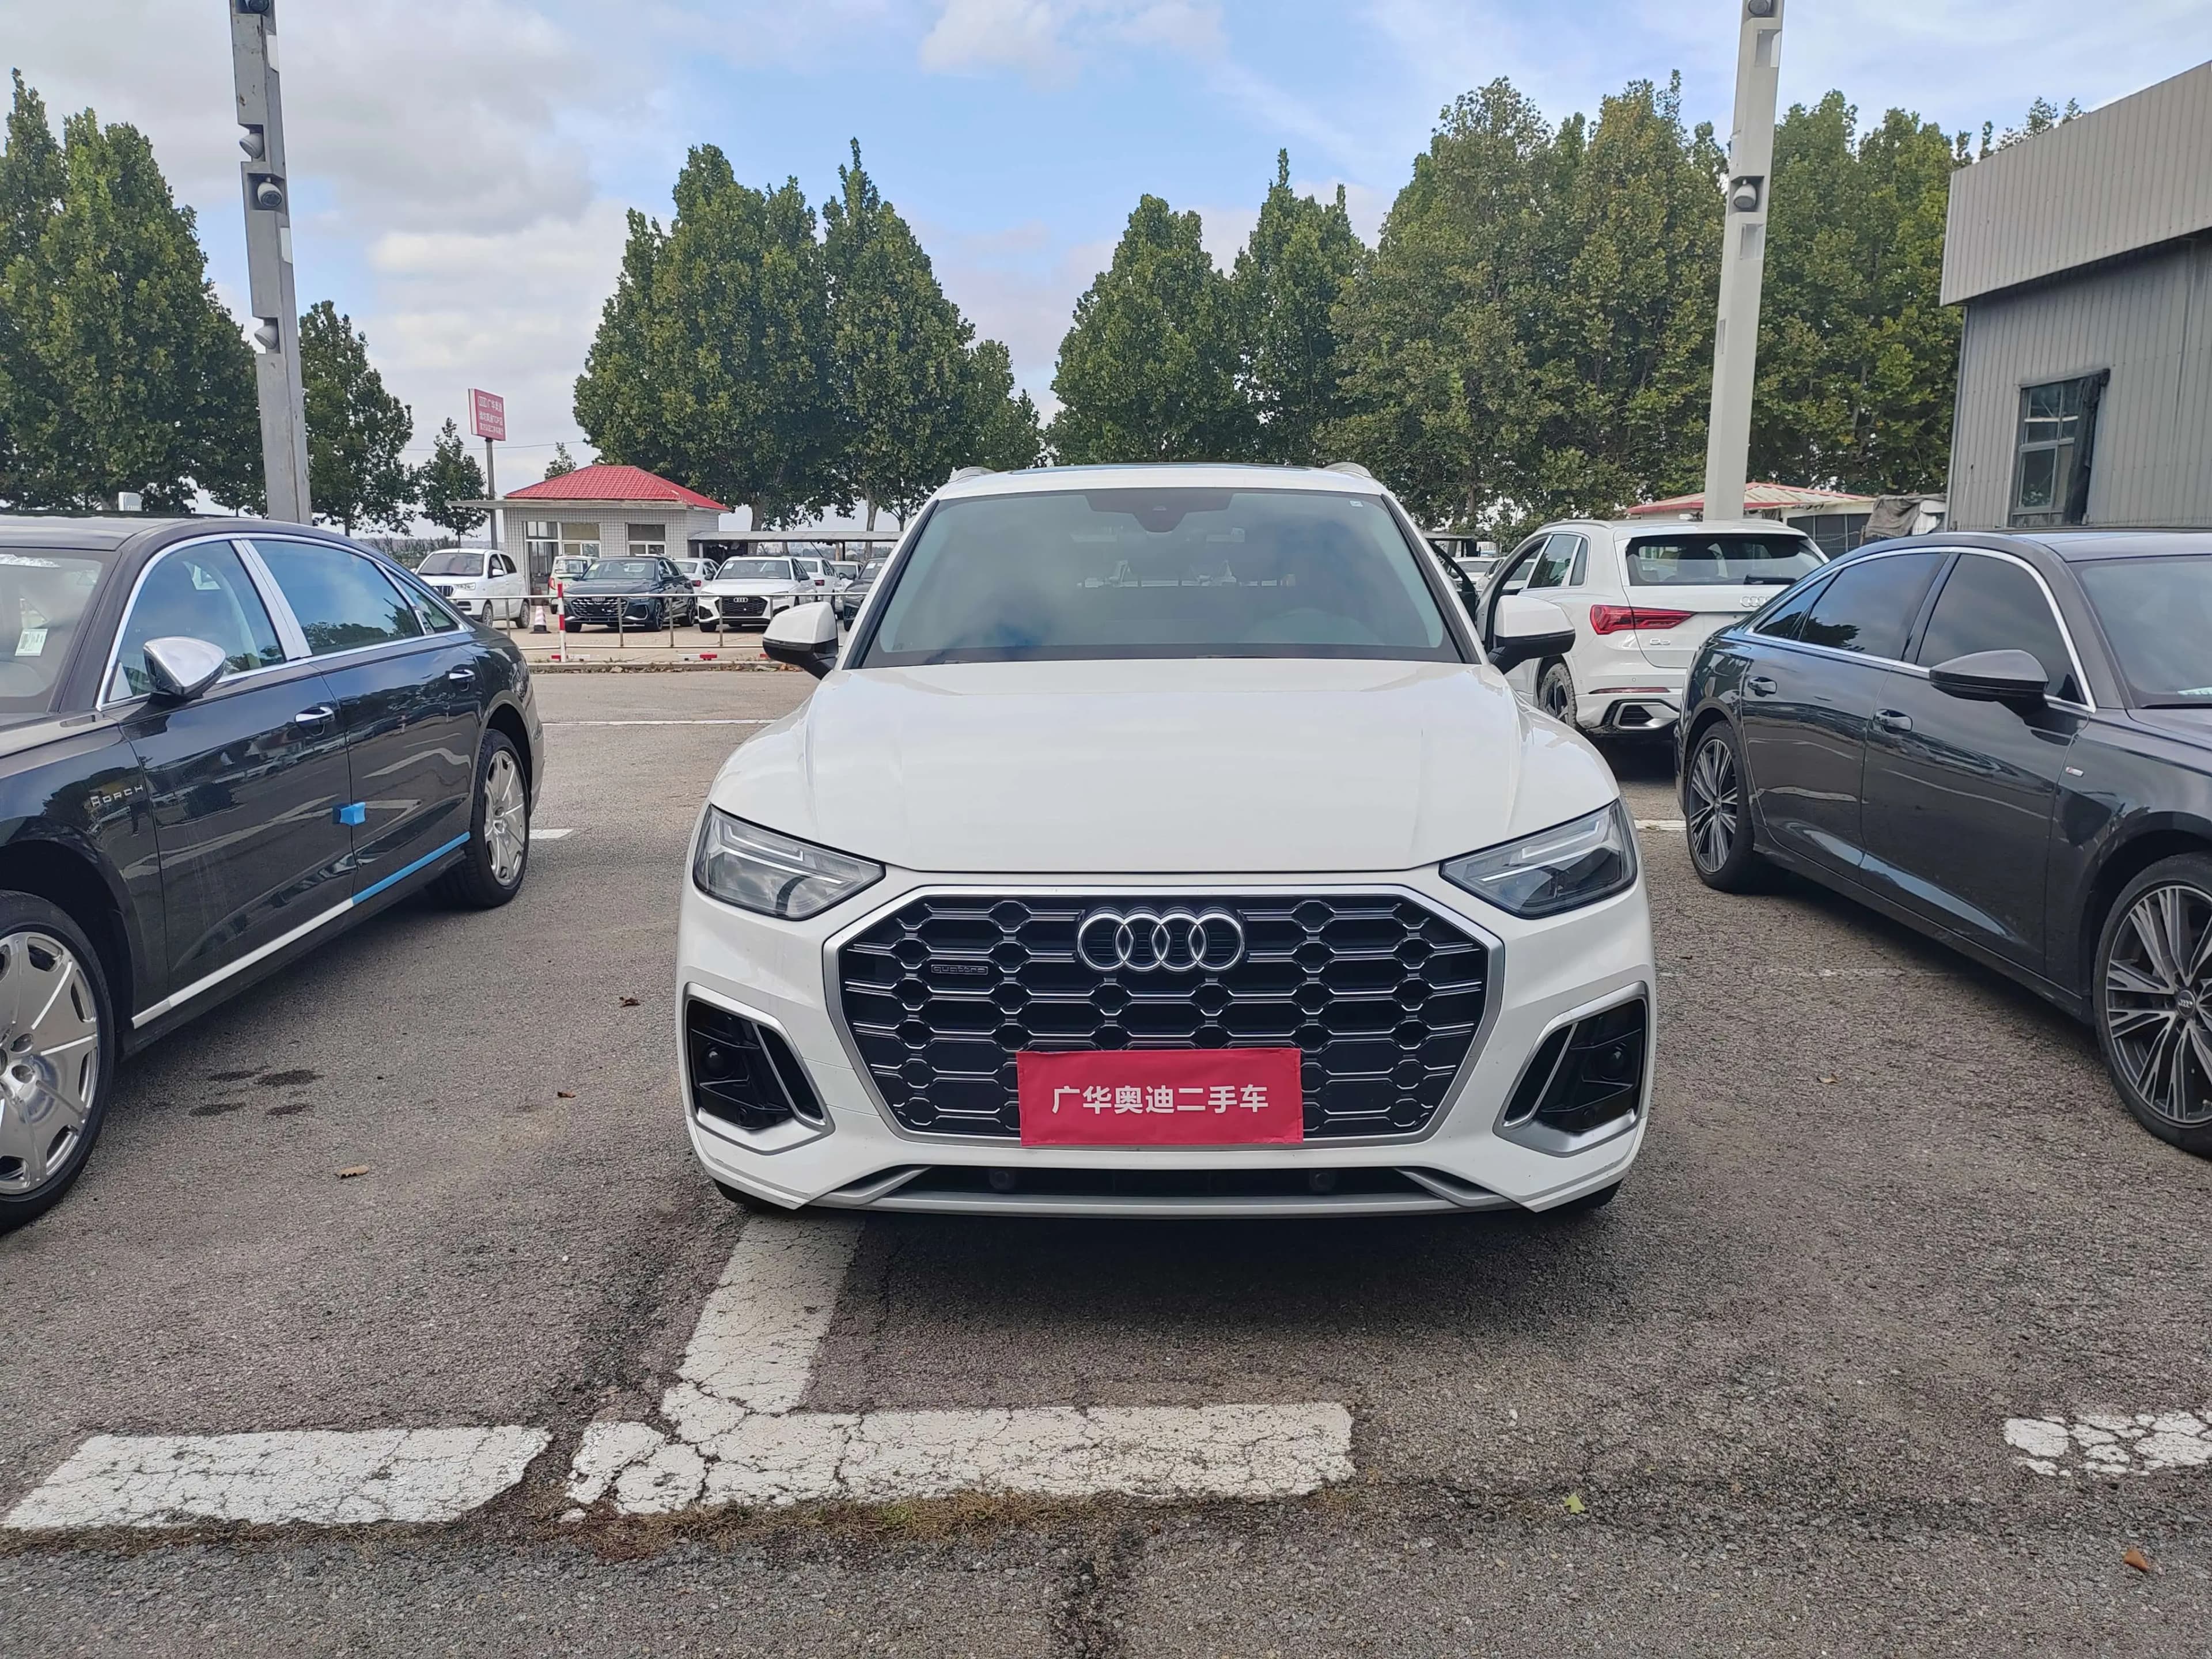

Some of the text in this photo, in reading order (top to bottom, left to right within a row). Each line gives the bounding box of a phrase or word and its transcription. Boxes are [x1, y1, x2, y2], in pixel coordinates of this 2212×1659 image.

[933, 965, 986, 974] quattro
[1051, 1084, 1269, 1114] 广华奥迪二手车
